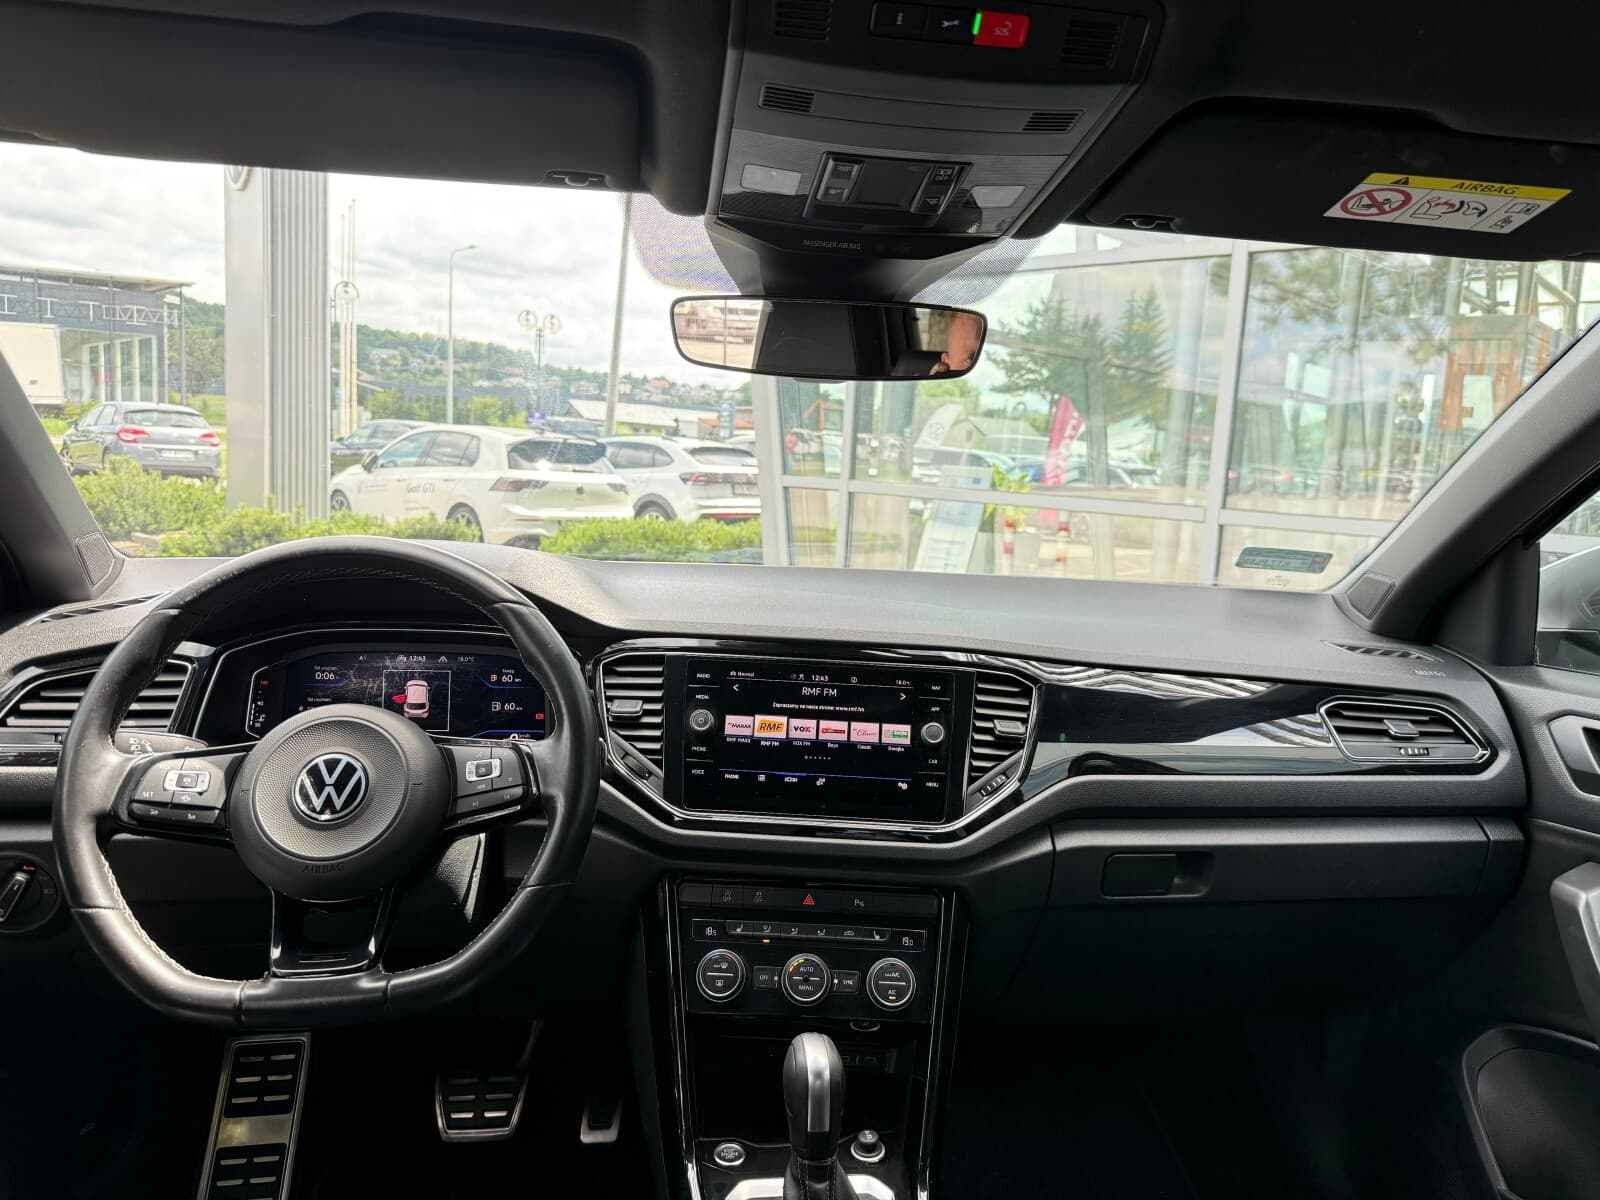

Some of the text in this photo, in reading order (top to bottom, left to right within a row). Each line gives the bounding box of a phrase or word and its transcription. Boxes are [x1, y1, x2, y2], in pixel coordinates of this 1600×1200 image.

[1451, 181, 1520, 195] AIRBAG
[803, 239, 836, 249] PASSENGER
[406, 482, 436, 494] Golf GTI
[315, 671, 335, 680] 0:06
[501, 674, 513, 682] 60
[811, 674, 829, 682] 12:43
[801, 686, 837, 697] RMF FM
[504, 702, 515, 711] 60
[759, 721, 784, 732] RMF
[302, 864, 344, 873] AIRBAG
